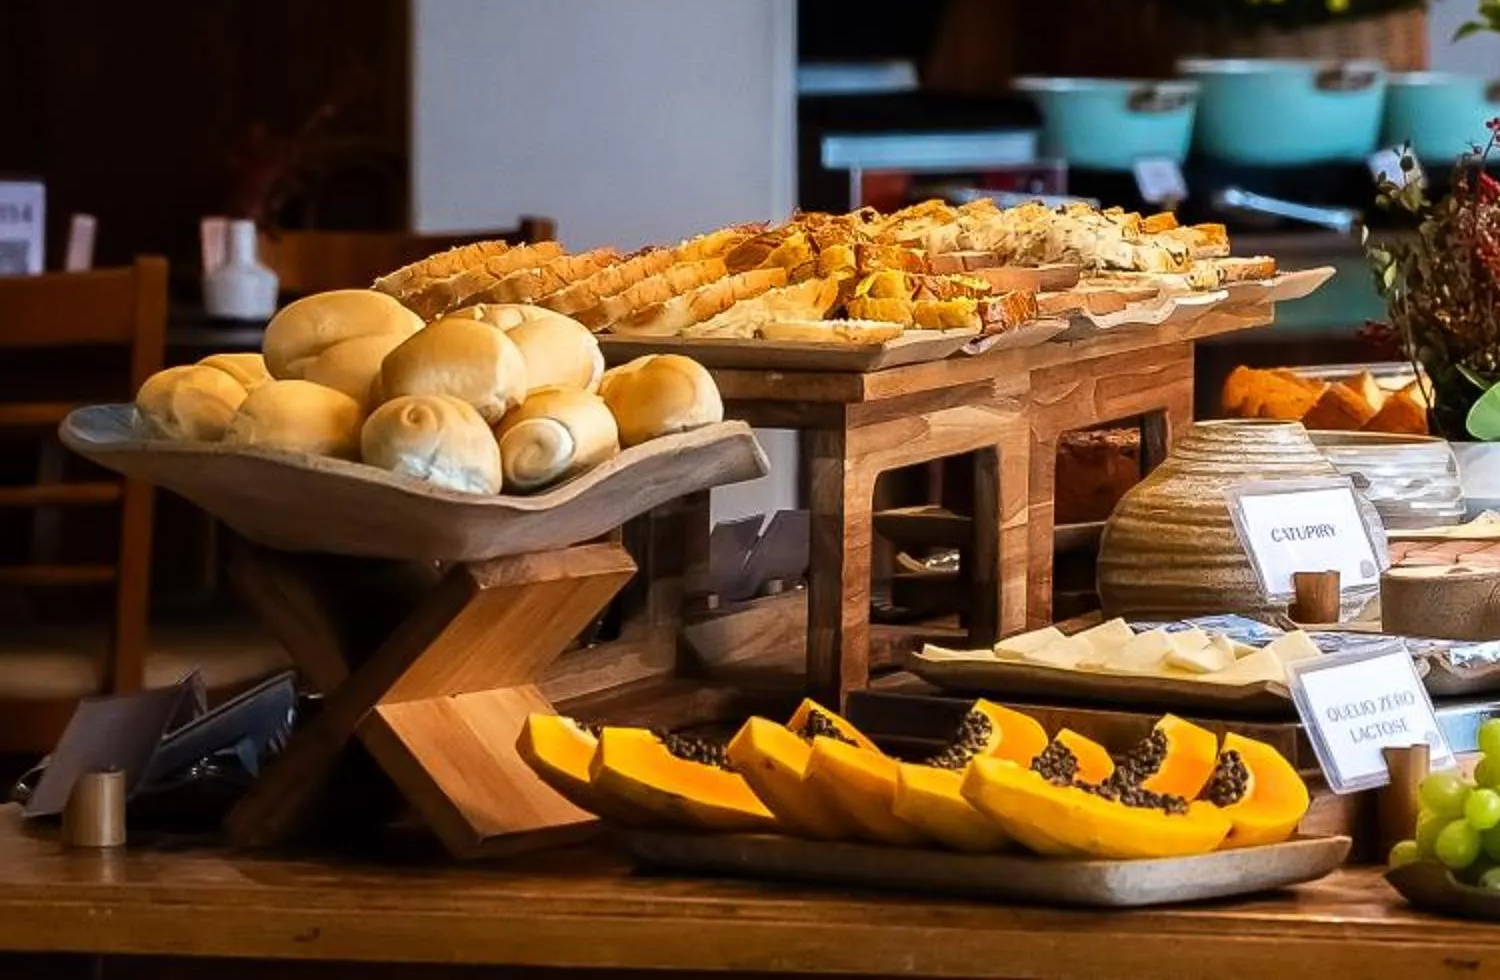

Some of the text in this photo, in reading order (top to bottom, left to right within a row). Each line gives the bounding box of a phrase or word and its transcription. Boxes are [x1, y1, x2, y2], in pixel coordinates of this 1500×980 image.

[1270, 523, 1337, 543] CATUPIRY
[1377, 689, 1416, 713] ZERO
[1349, 717, 1409, 744] LACTOSE
